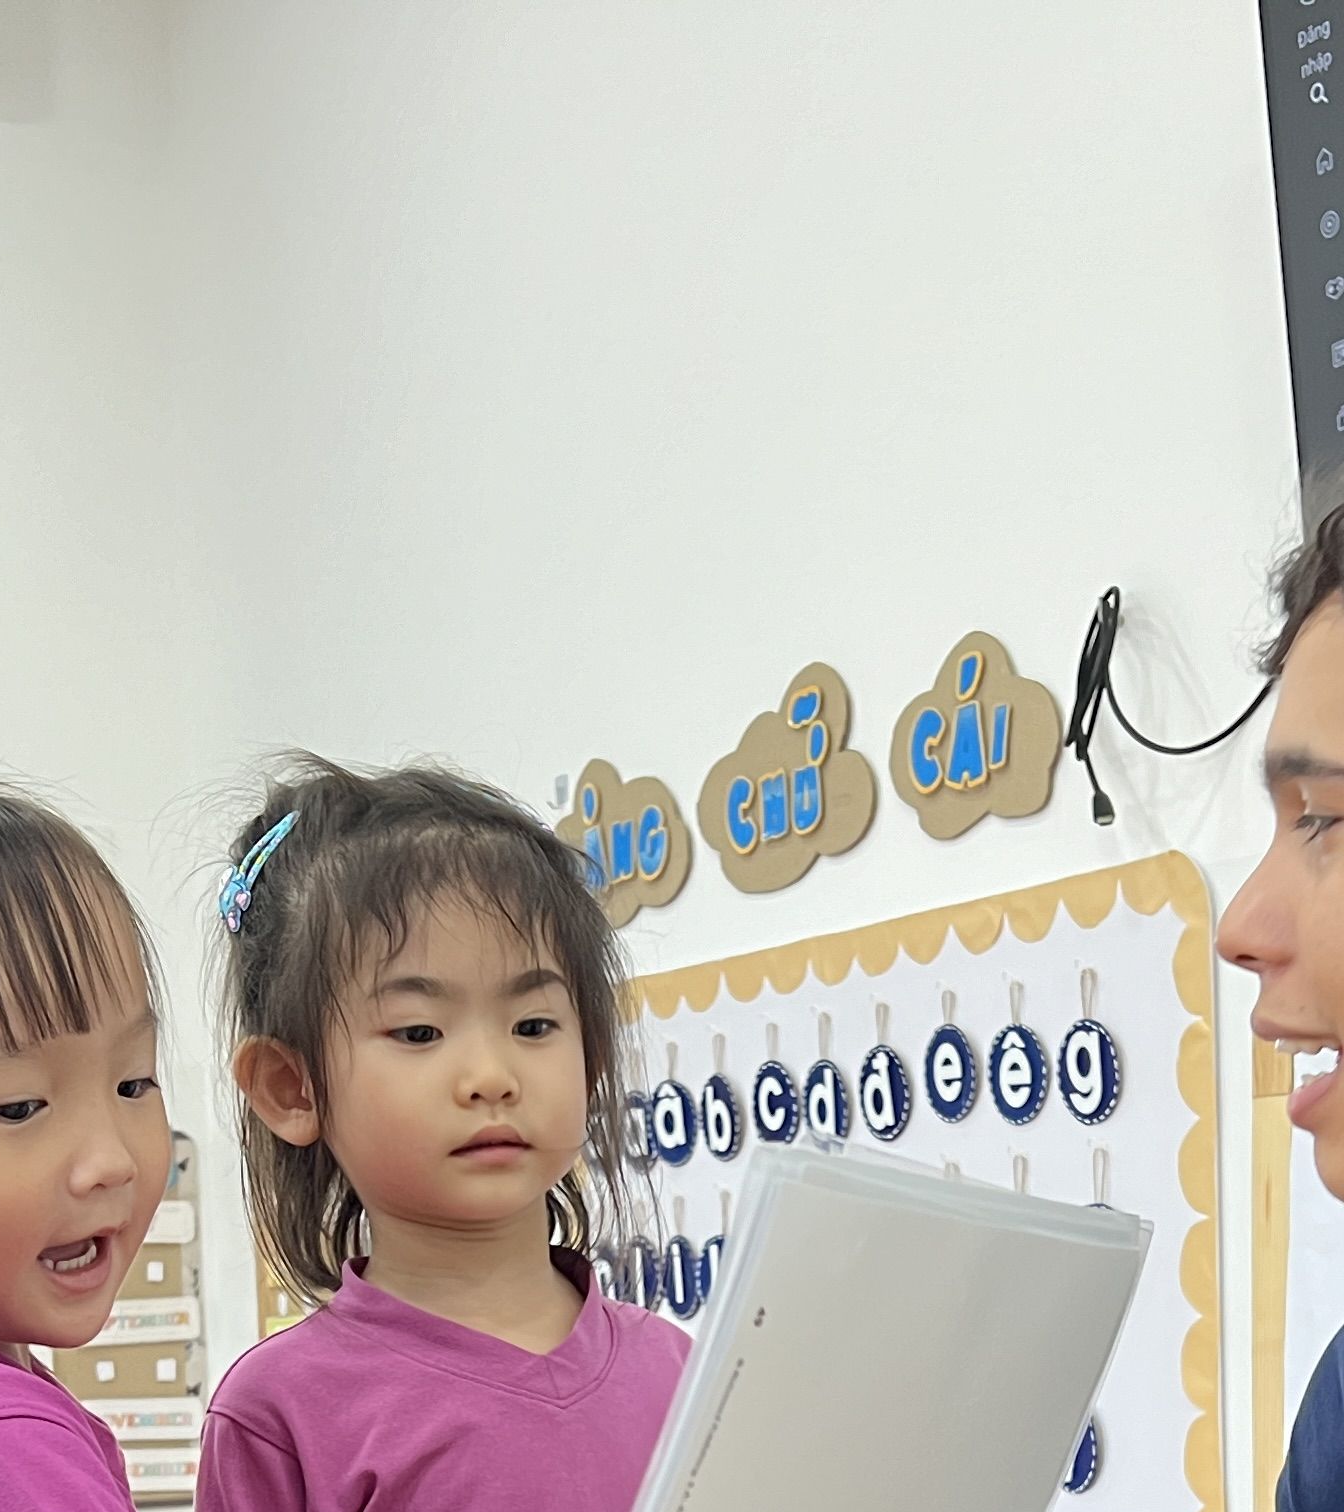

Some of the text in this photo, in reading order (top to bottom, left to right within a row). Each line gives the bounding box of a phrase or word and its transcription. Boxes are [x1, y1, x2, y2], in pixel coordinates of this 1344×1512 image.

[909, 650, 1012, 795] CÁI
[704, 1085, 733, 1153] b
[758, 1075, 786, 1132] c
[808, 1068, 837, 1137] d
[862, 1052, 897, 1132] đ
[933, 1042, 963, 1103] e
[999, 1031, 1034, 1109] ê
[1066, 1029, 1104, 1116] g
